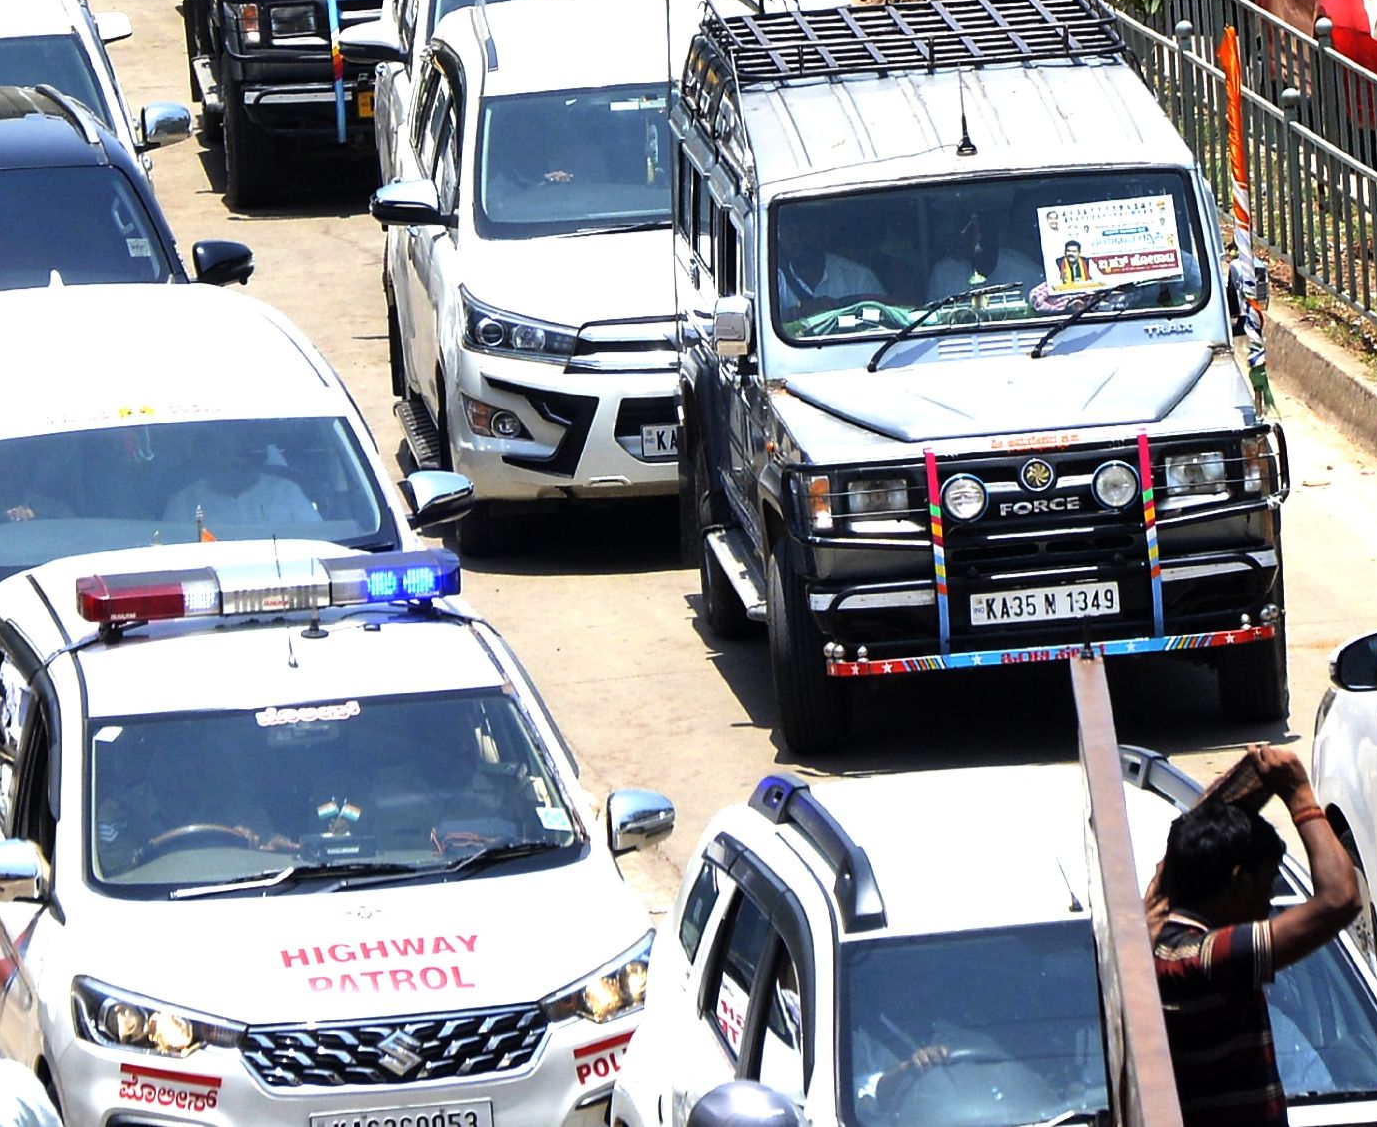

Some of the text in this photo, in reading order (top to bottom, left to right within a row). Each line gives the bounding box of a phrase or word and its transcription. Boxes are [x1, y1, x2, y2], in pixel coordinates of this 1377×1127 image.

[1145, 323, 1194, 337] TRAX
[1000, 497, 1080, 516] FORCE
[986, 595, 1036, 620] KA35
[1067, 589, 1114, 613] 1349
[281, 935, 478, 968] HIGHWAY
[308, 966, 475, 992] PATROL
[119, 1074, 219, 1113] ಪೊಲೀಸ್
